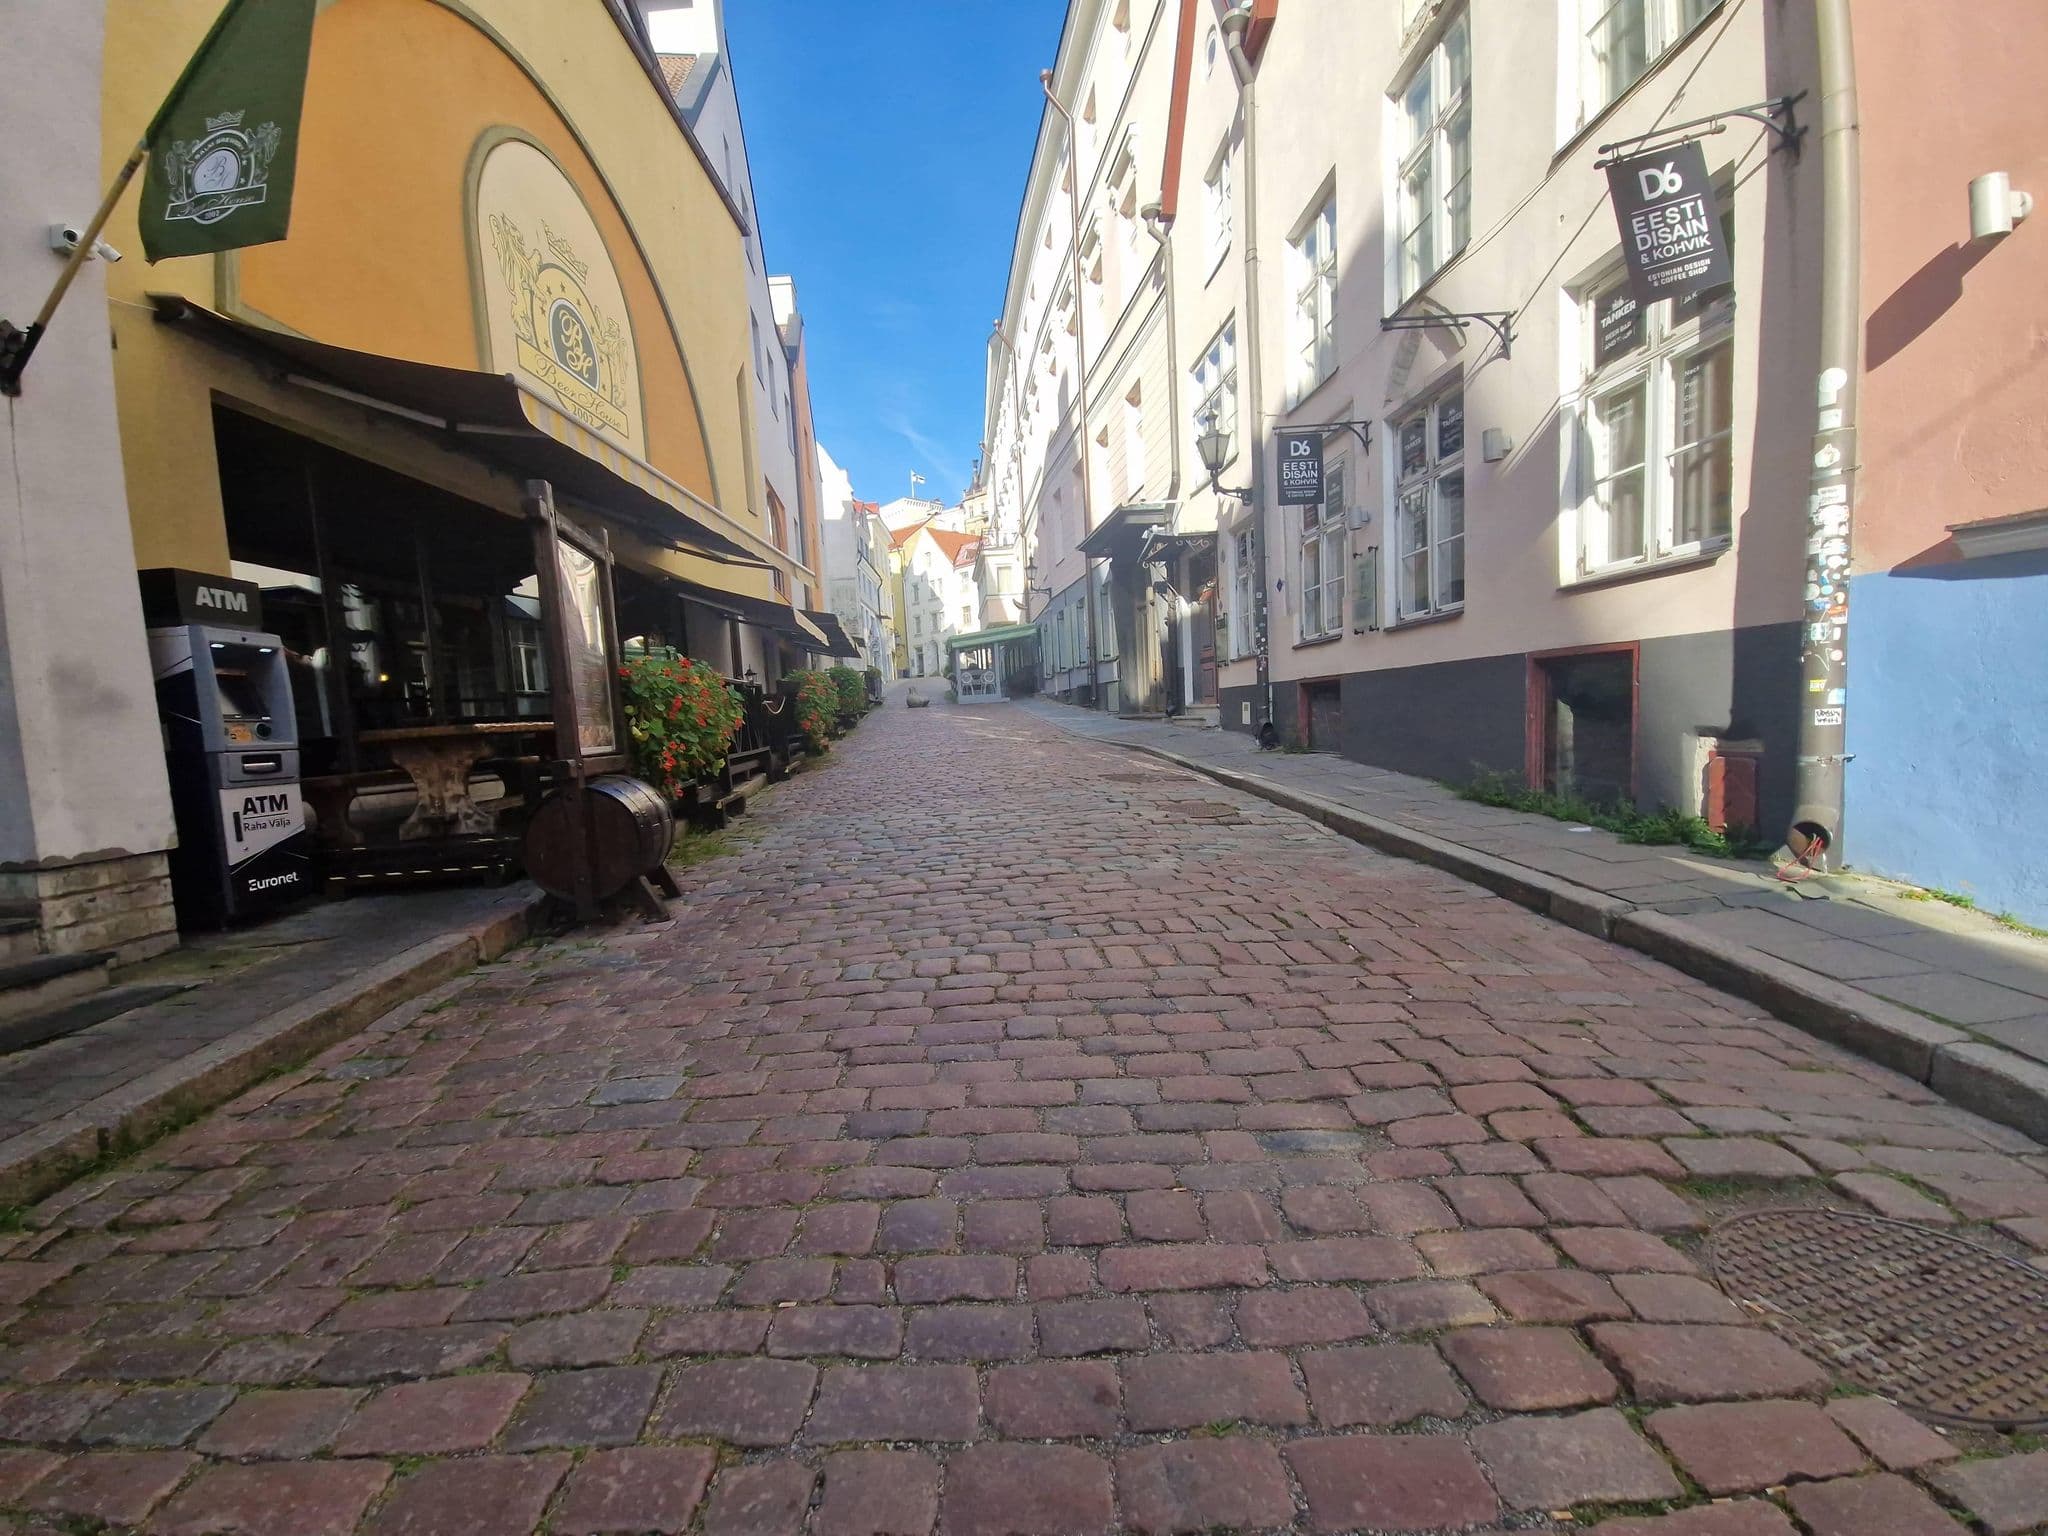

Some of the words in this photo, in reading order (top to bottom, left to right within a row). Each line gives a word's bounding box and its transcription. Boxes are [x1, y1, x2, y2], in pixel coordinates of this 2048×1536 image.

[1638, 162, 1683, 201] D6
[1632, 199, 1704, 235] EESTI
[1635, 216, 1709, 251] DISAIN
[1640, 253, 1650, 264] &
[1653, 233, 1711, 260] KOHVIK
[1647, 266, 1683, 282] ESTONIAN
[1684, 258, 1711, 271] DESIGN
[1660, 271, 1687, 285] COFFEE
[1688, 266, 1708, 277] SHOP
[1600, 300, 1637, 329] TANKER
[535, 354, 576, 397] Beer
[578, 390, 622, 428] House
[571, 404, 596, 426] 2002
[1290, 440, 1311, 457] D6
[1283, 461, 1318, 471] EESTI
[1283, 470, 1318, 479] DISAIN
[196, 586, 248, 612] ATM
[243, 794, 288, 815] ATM
[244, 821, 267, 832] Raha
[269, 817, 291, 828] Välja
[248, 872, 300, 892] Euronet
